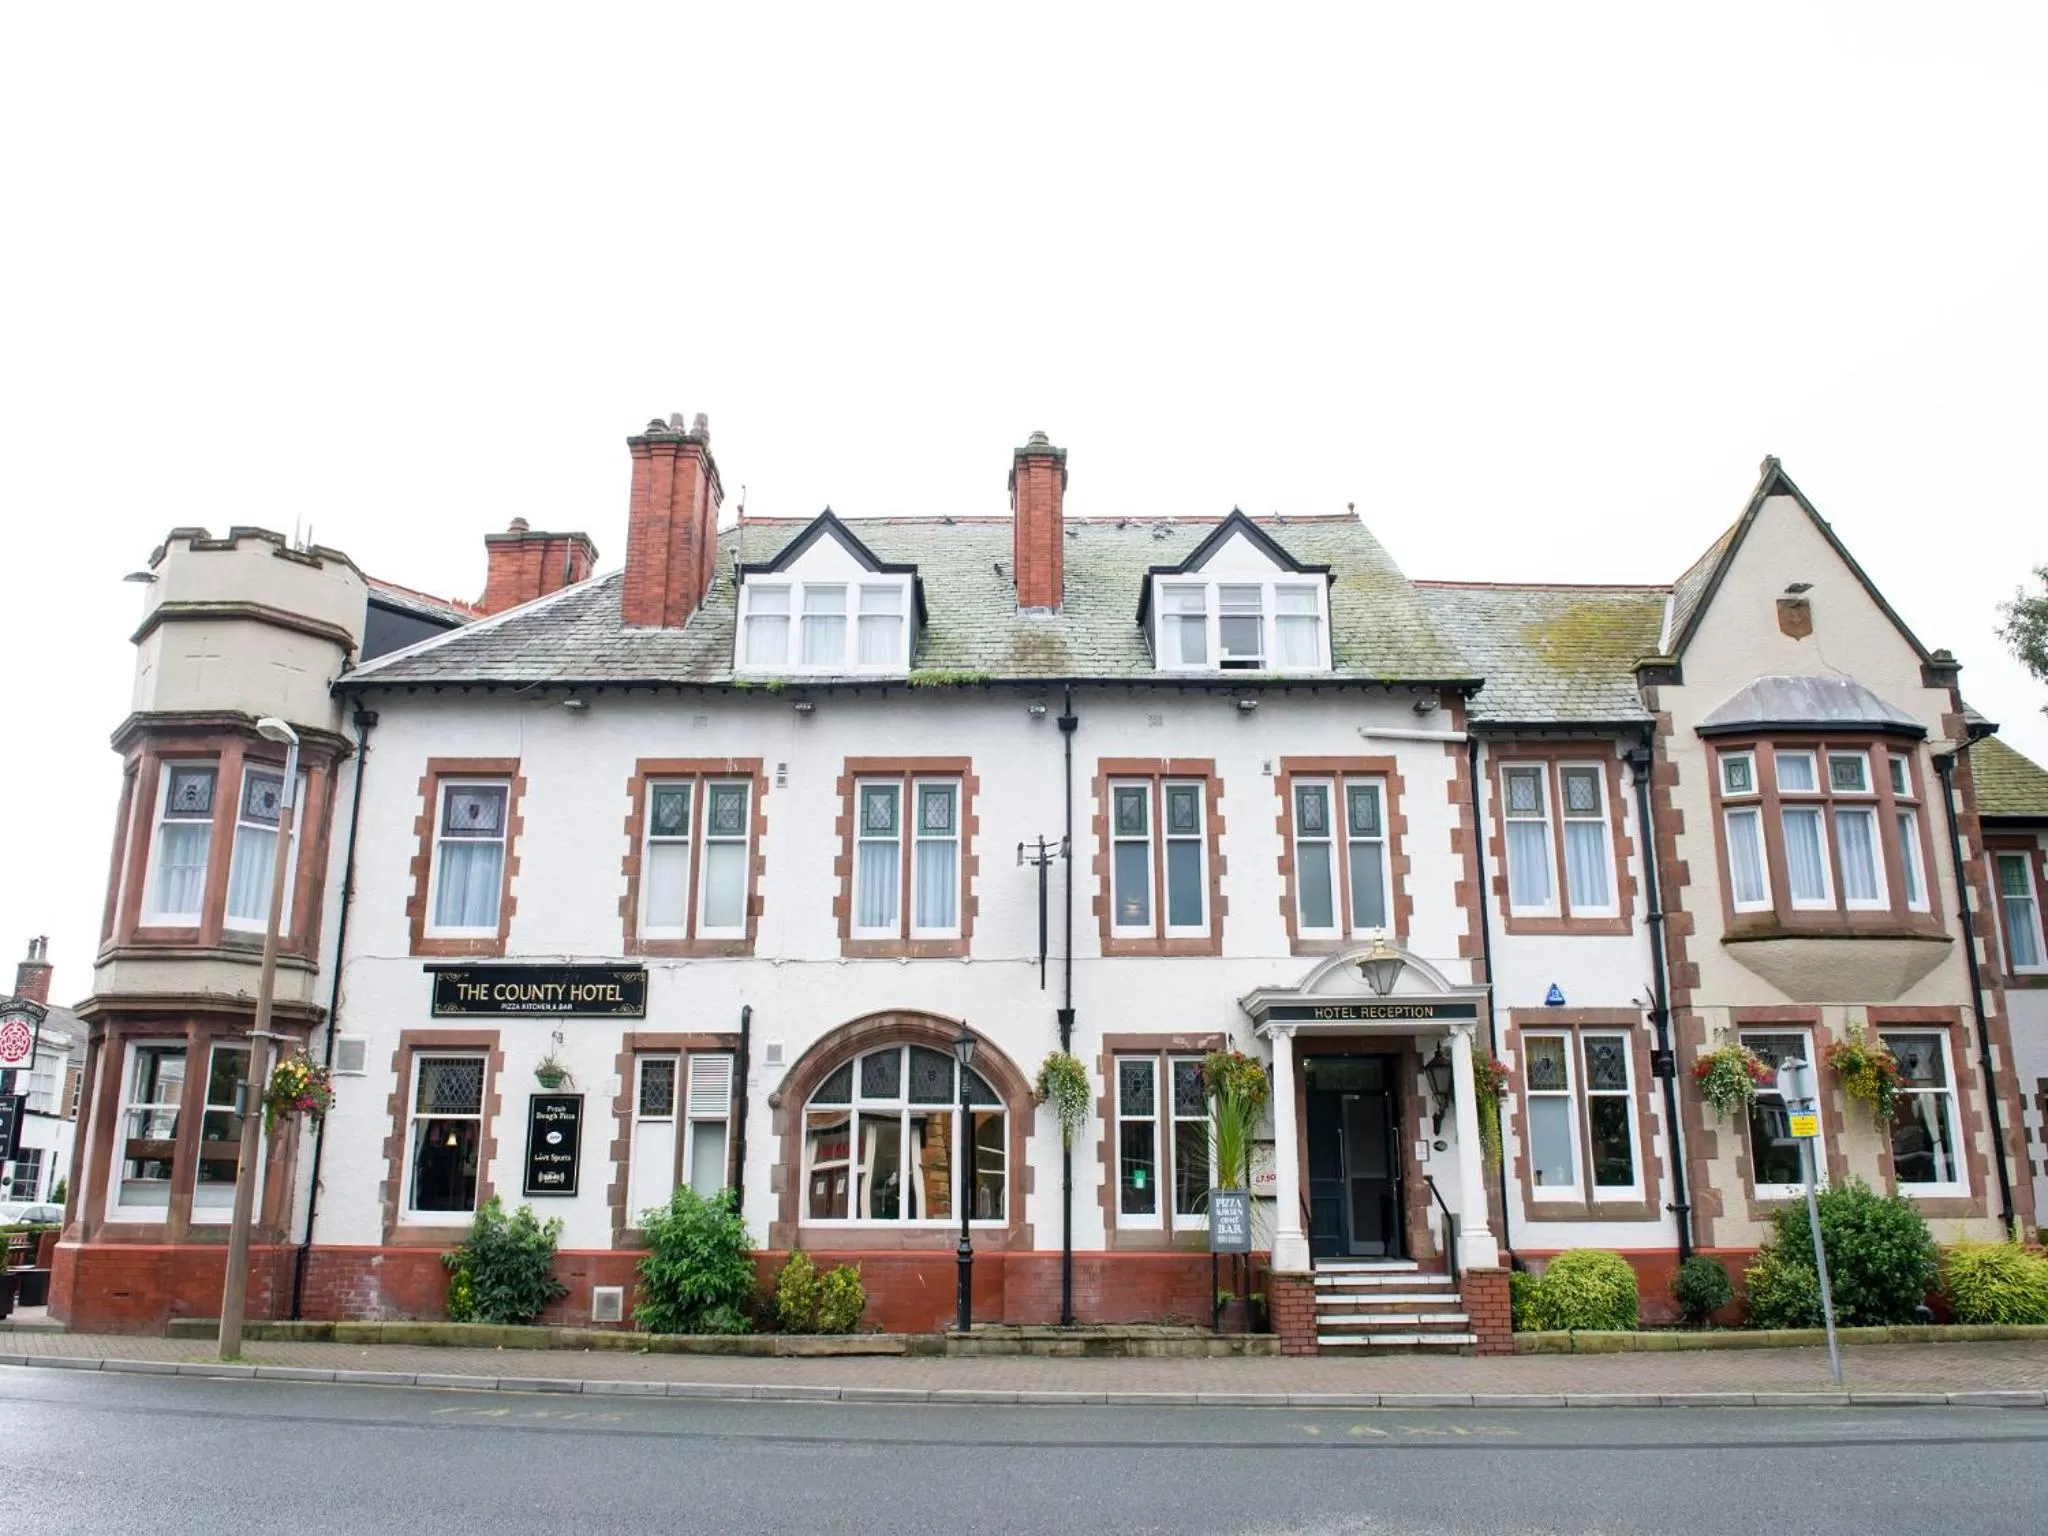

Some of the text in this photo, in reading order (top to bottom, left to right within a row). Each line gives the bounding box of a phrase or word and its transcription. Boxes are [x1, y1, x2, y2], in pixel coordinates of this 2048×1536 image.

[457, 983, 624, 1001] THE COUNTY HOTEL
[1314, 1006, 1433, 1019] HOTEL RECEPTION
[547, 1105, 567, 1113] Fresh
[535, 1112, 575, 1121] Dough Pizza
[534, 1153, 572, 1163] Live Sports
[1215, 1199, 1242, 1208] PIZZA
[1217, 1225, 1243, 1234] BAR
